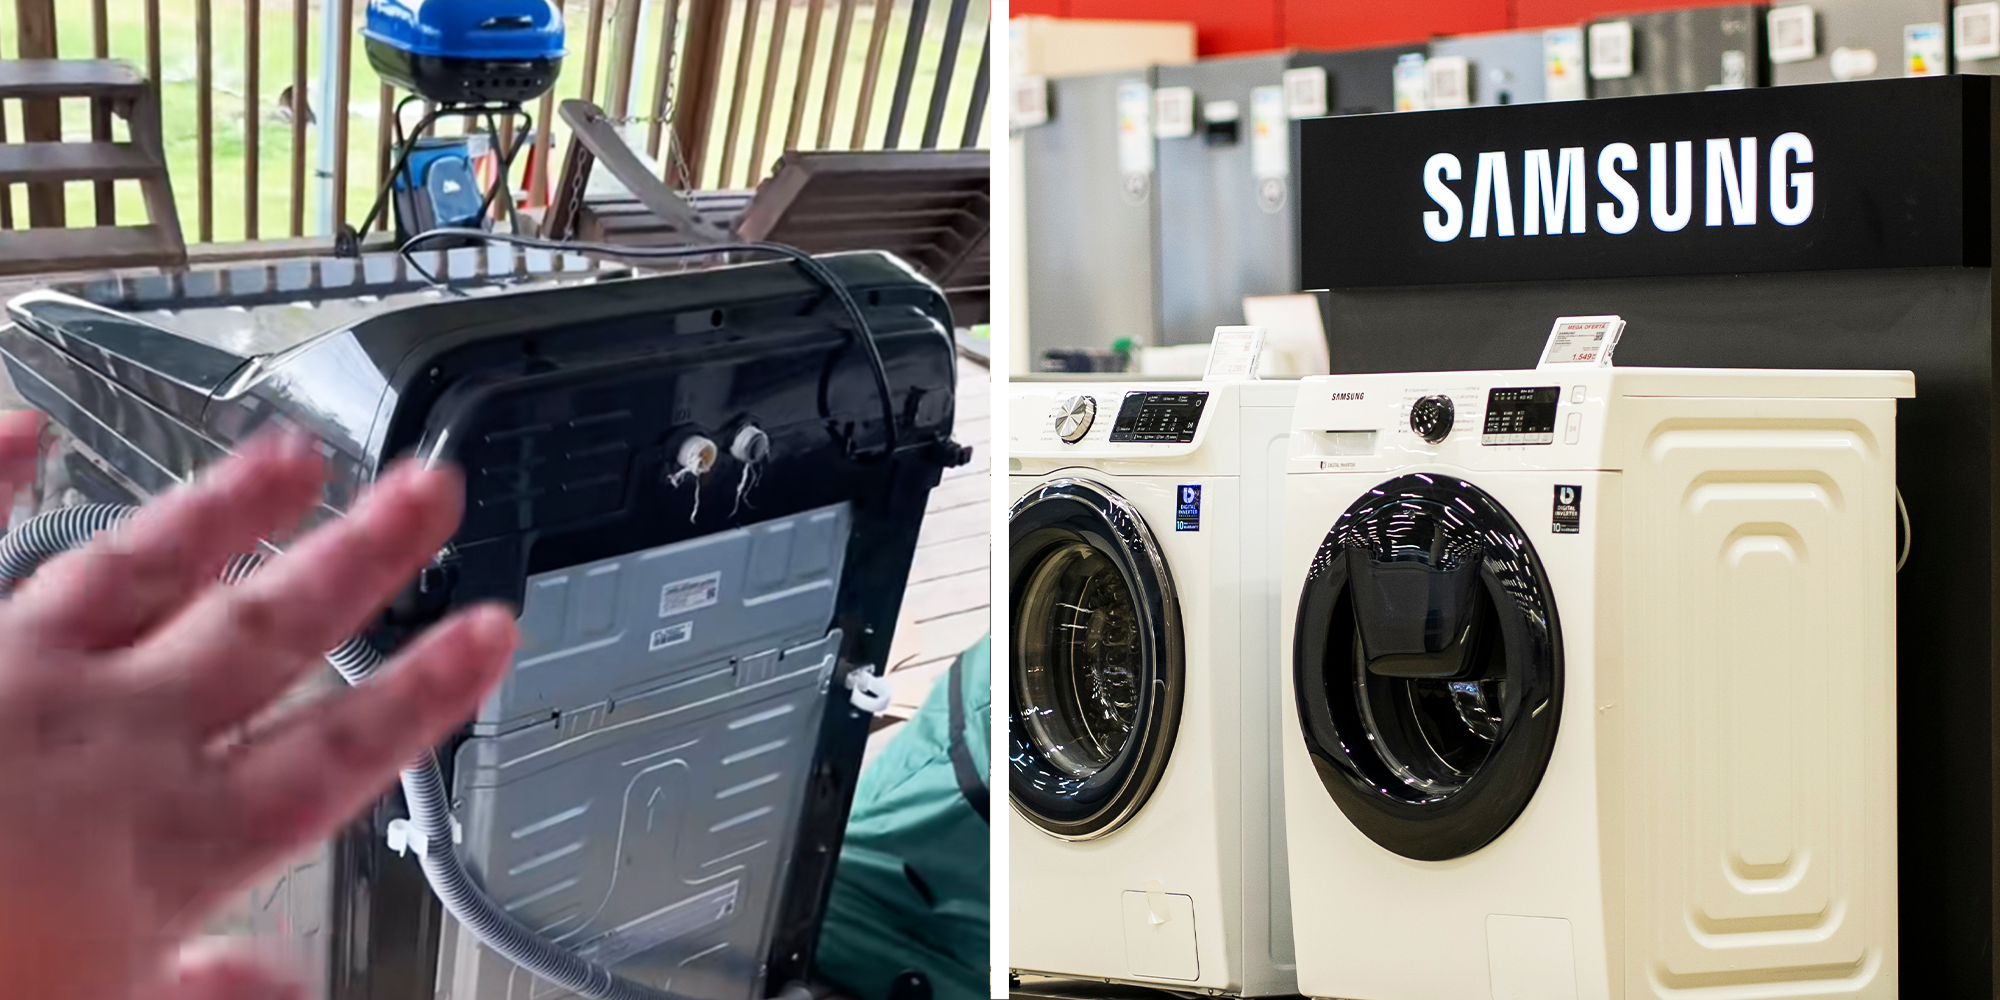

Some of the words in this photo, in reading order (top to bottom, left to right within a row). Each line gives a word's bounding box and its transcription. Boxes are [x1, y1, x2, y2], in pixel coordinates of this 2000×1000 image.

[1422, 131, 1814, 242] SAMSUNG
[1331, 392, 1365, 401] SAMSUNG
[1177, 521, 1184, 530] 10
[1553, 523, 1560, 532] 10
